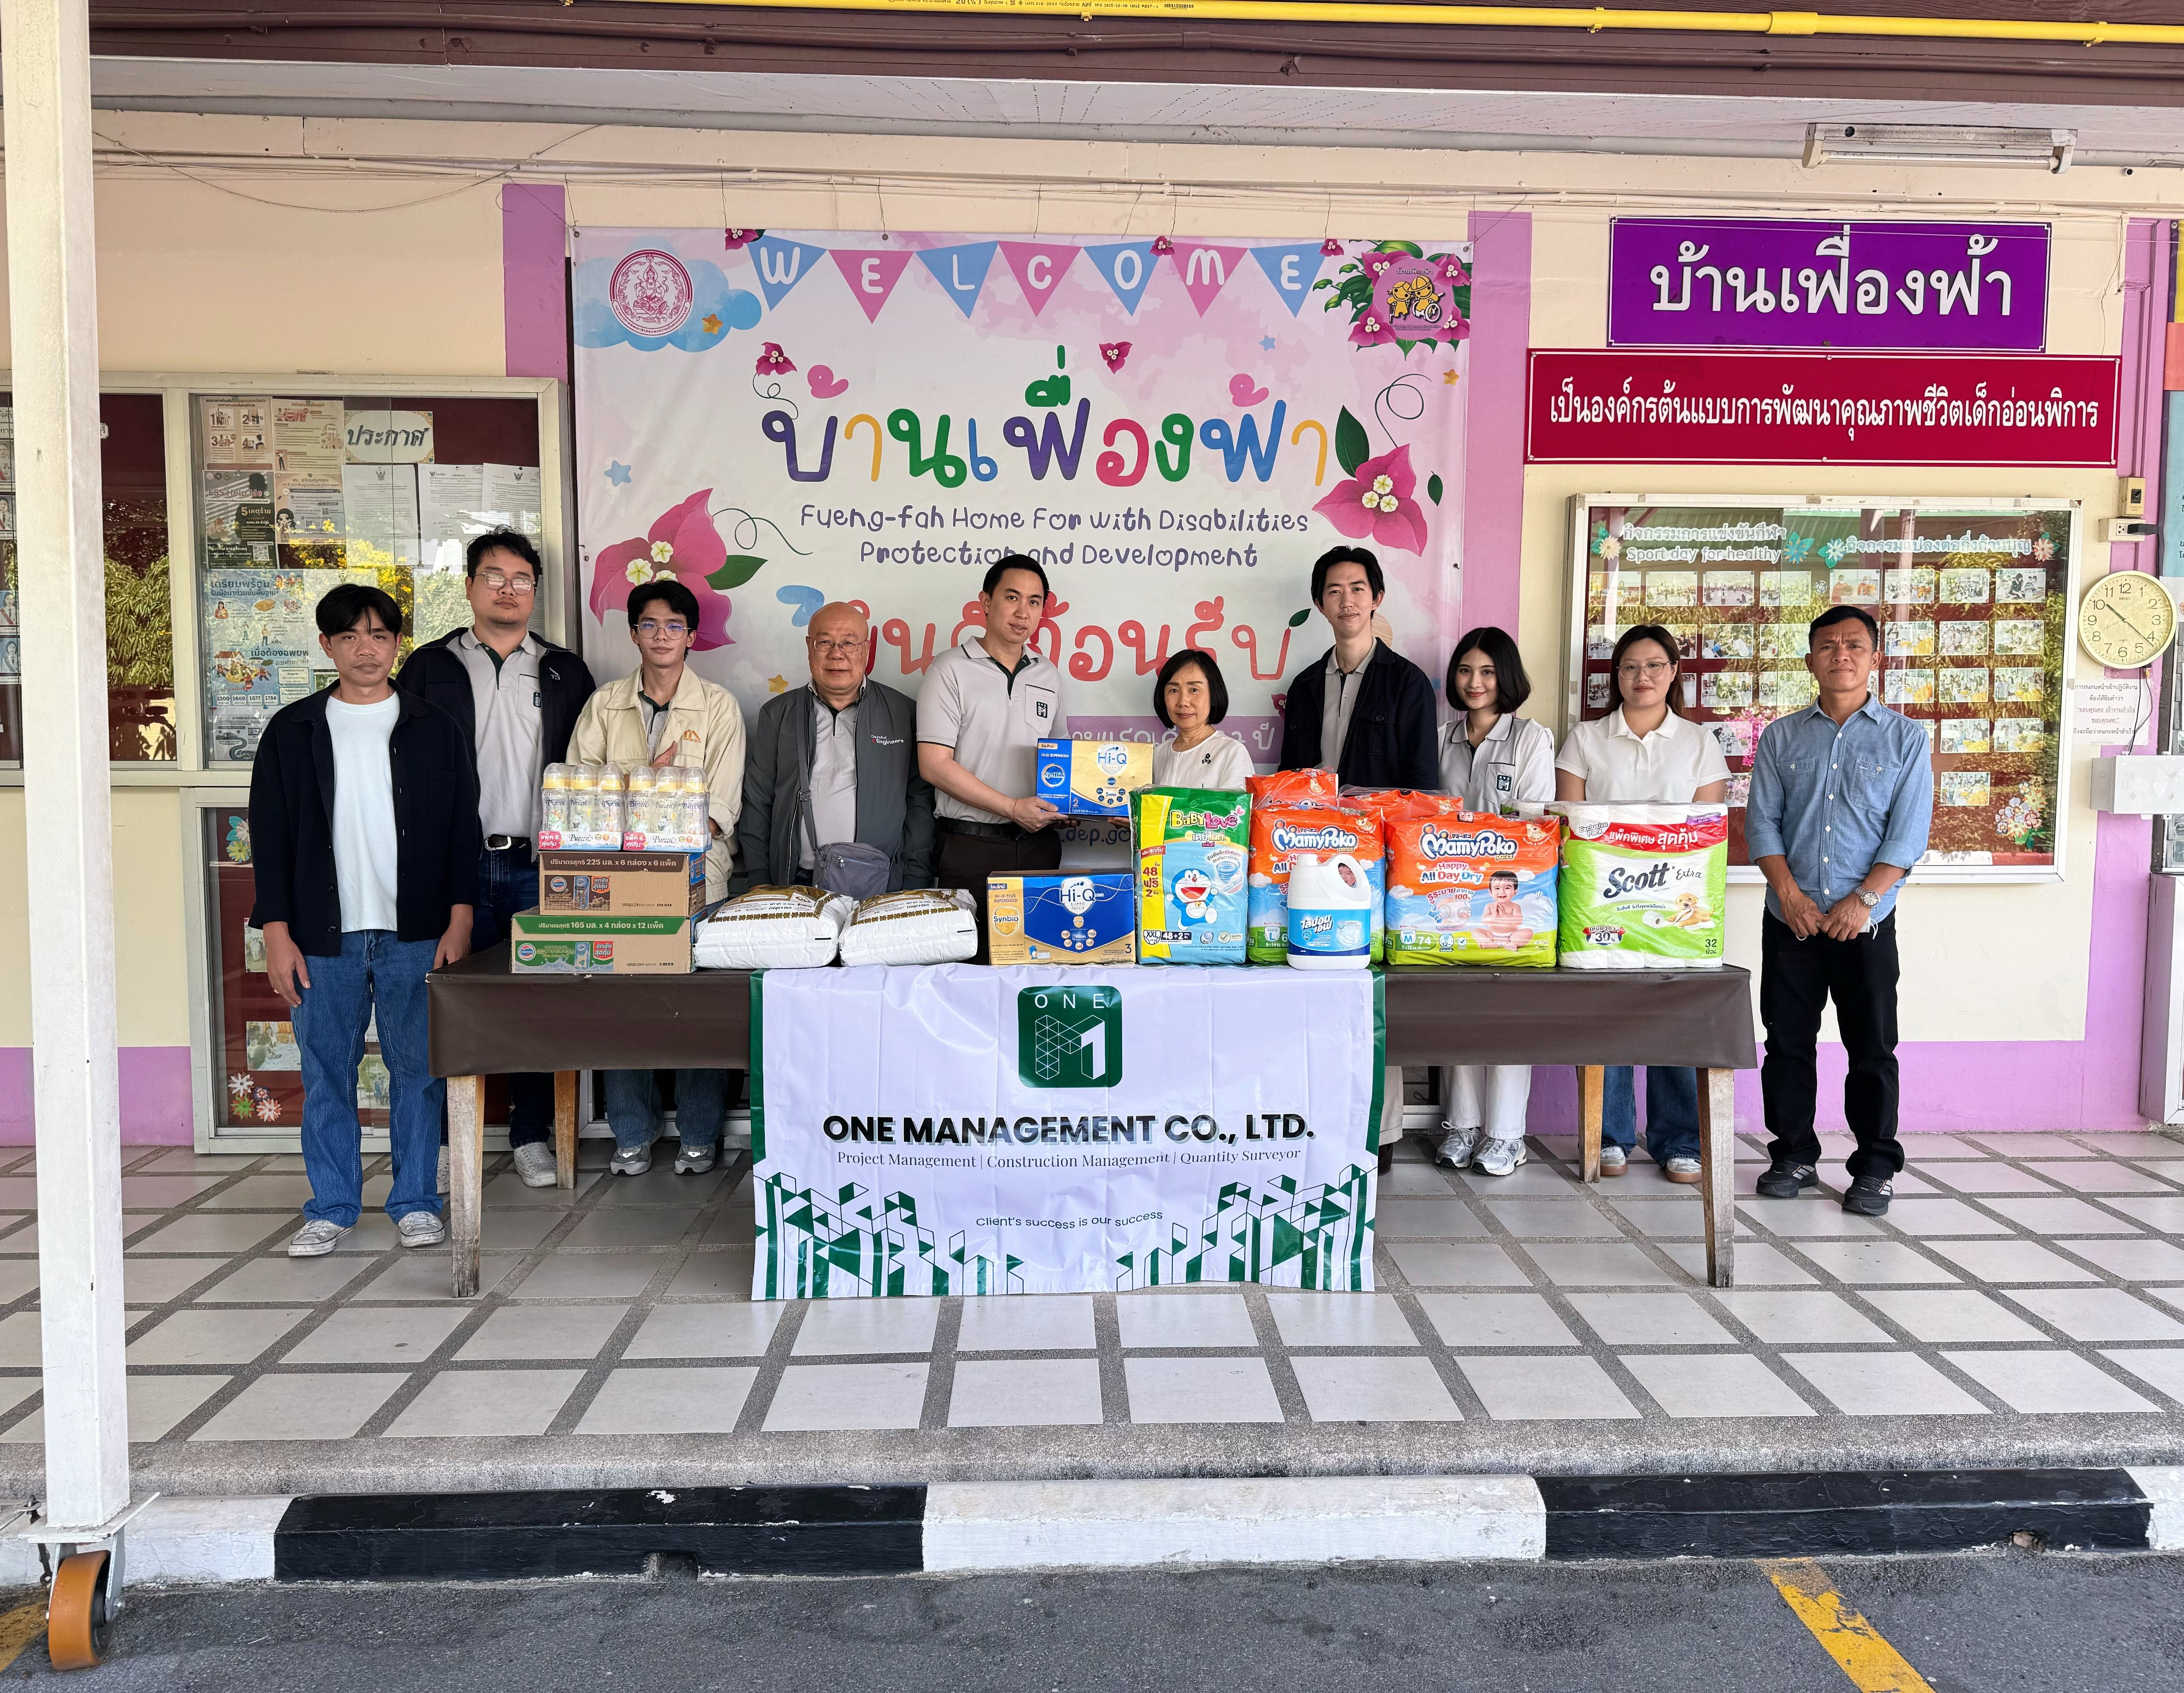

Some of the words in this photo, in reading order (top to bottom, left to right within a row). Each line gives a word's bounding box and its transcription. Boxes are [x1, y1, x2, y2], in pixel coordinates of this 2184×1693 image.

[1650, 225, 2013, 317] บ้านเฟื่องฟ้า
[1550, 377, 2097, 441] เป็นองค์กรต้นแบบการพัฒนาคุณภาพชีวิตเด็กอ่อนพิการ
[242, 415, 249, 424] 2
[761, 344, 1328, 488] บ้านเฟื่องฟ้า
[347, 424, 430, 446] ประกาศ
[211, 436, 218, 446] 3
[953, 507, 1025, 530] Home
[1033, 507, 1081, 530] For
[1159, 508, 1308, 533] Disabilities
[1623, 522, 1787, 541] กิจกรรมการแข่งขันกีฬา
[861, 541, 1016, 565] Protection
[1030, 541, 1073, 565] and
[1082, 543, 1258, 572] Development
[1627, 547, 1666, 563] Sport
[1670, 547, 1698, 563] day
[1702, 547, 1720, 562] for
[1727, 546, 1781, 564] healthy
[211, 578, 269, 589] เตรียมพร้อม
[2119, 583, 2131, 594] 12
[2105, 587, 2114, 598] 11
[2092, 600, 2105, 610] 10
[2149, 599, 2158, 609] 2
[2088, 615, 2097, 625] 9
[2152, 615, 2161, 625] 3
[2092, 631, 2101, 642] 8
[2146, 631, 2156, 641] 4
[2104, 643, 2112, 654] 7
[2118, 647, 2127, 657] 6
[2135, 643, 2143, 653] 5
[1252, 722, 1275, 750] ปี
[1098, 752, 1127, 765] Hi-Q
[1073, 798, 1079, 807] 2
[1578, 822, 1608, 833] Exclusive
[1587, 828, 1603, 837] Pack
[1273, 823, 1357, 851] MamyPoko
[1609, 828, 1655, 845] แพ็คพิเศษ
[1657, 829, 1698, 851] สุดคุ้ม
[1420, 831, 1516, 858] MamyPoko
[627, 858, 648, 866] กล่อง
[660, 858, 676, 866] แพ็ค
[1274, 863, 1287, 872] All
[1143, 867, 1158, 876] 48
[1422, 872, 1435, 880] All
[1438, 871, 1460, 882] Day
[1461, 871, 1482, 883] Dry
[1676, 869, 1703, 880] Extra
[1144, 877, 1159, 888] ฟรี
[1603, 862, 1670, 898] Scott
[1060, 888, 1095, 902] Hi-Q
[1269, 932, 1275, 941] L
[1418, 936, 1431, 945] 74
[1595, 933, 1615, 942] 30%
[1125, 943, 1132, 953] 3
[1705, 939, 1717, 948] 32
[1034, 993, 1105, 1009] ONE
[823, 1115, 897, 1144] ONE
[903, 1115, 1157, 1145] MANAGEMENT
[1164, 1114, 1239, 1146] CO.,
[1245, 1113, 1314, 1140] LTD.
[838, 1151, 885, 1168] Project
[888, 1153, 976, 1169] Management
[987, 1154, 1077, 1167] Construction
[1082, 1154, 1169, 1168] Management
[1180, 1151, 1238, 1165] Quantity
[1242, 1150, 1301, 1163] Surveyor
[1025, 1219, 1075, 1229] success
[1079, 1217, 1087, 1227] is
[1091, 1217, 1111, 1225] our
[1115, 1212, 1163, 1226] success
